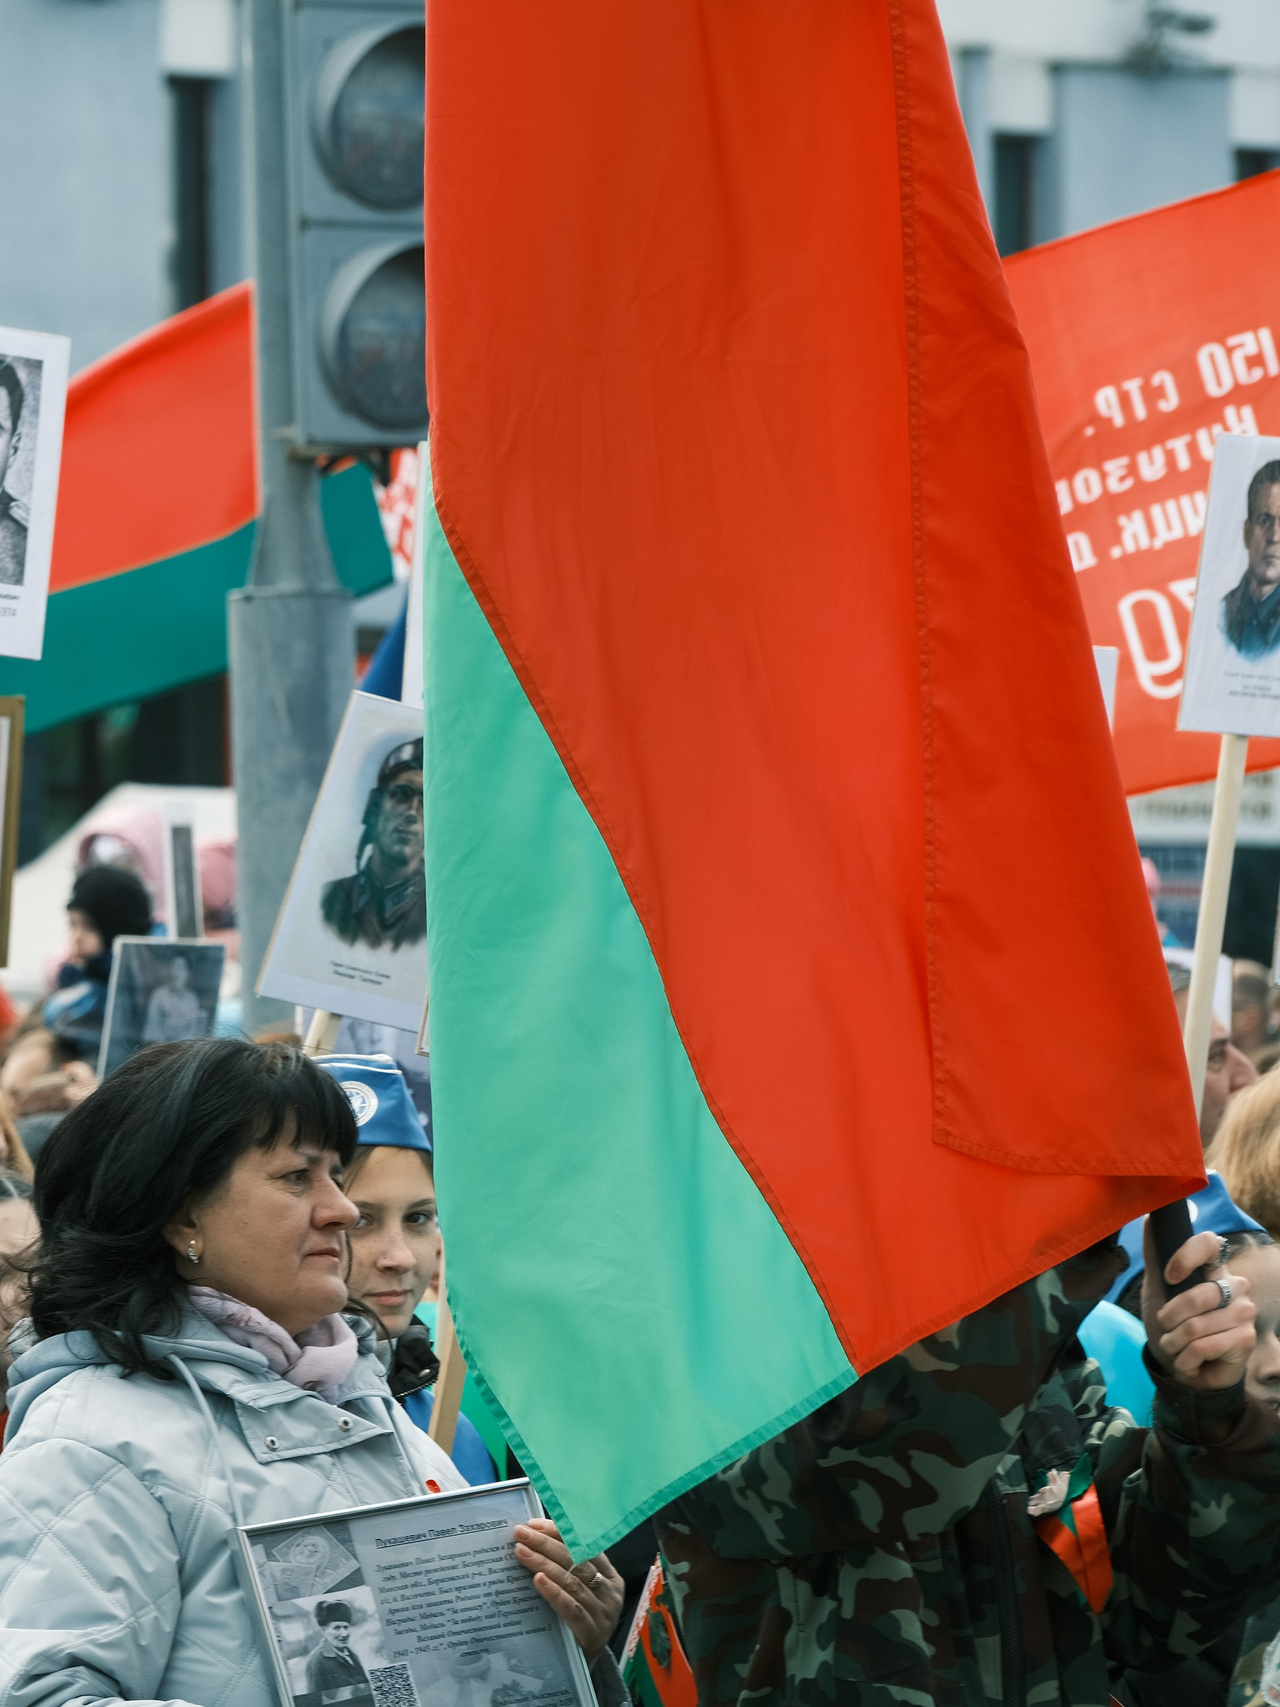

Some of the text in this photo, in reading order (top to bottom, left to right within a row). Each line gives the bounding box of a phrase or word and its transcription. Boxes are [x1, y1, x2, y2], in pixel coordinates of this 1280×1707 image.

[375, 1518, 508, 1548] Лукашевич Павел Захарович
